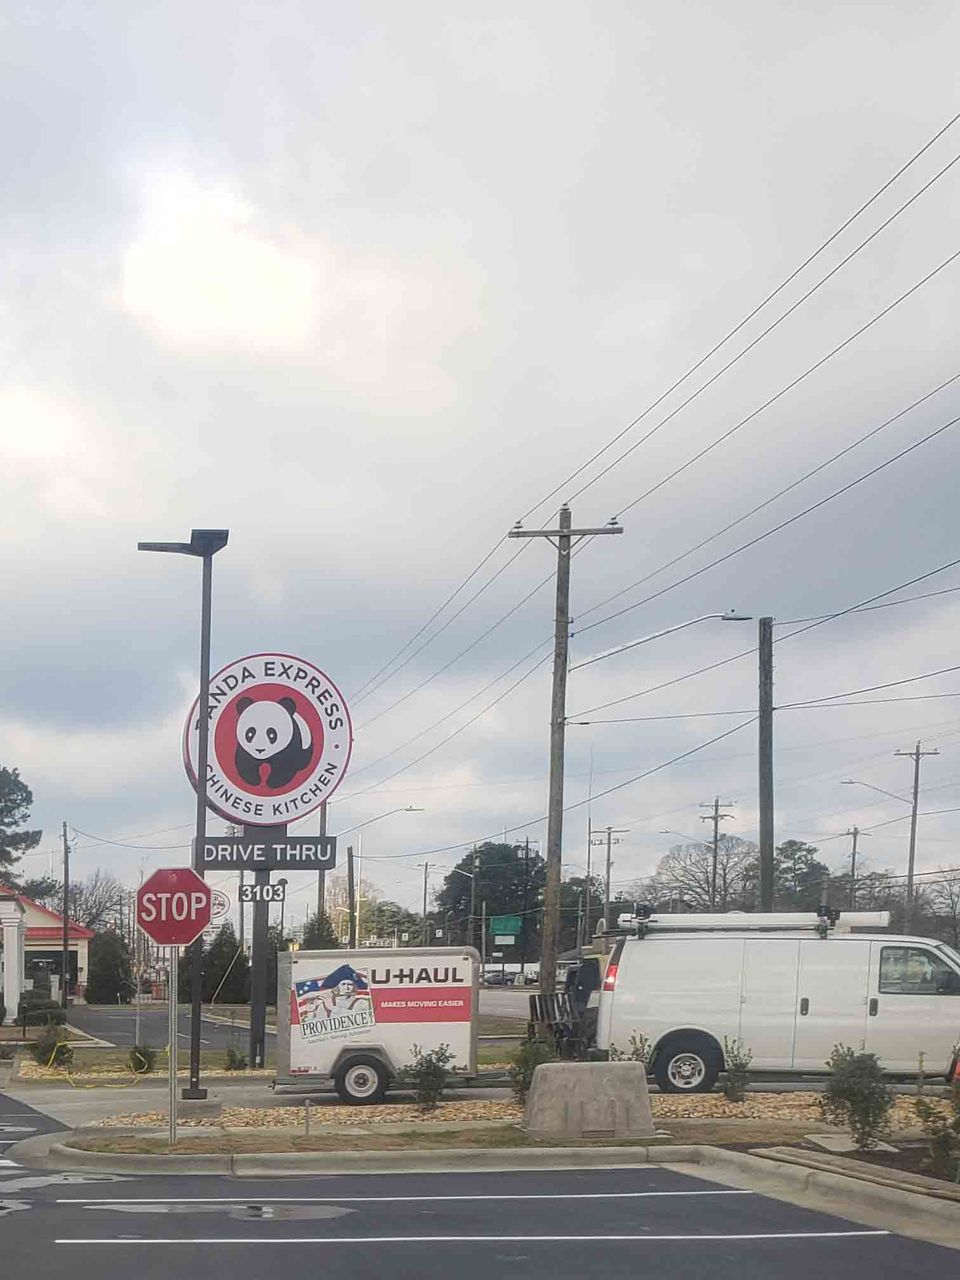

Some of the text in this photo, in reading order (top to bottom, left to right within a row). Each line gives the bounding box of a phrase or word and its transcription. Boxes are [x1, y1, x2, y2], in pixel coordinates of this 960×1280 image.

[264, 661, 343, 730] EXPRESS
[272, 762, 338, 816] KITCHEN
[204, 844, 331, 861] DRIVE THRU
[242, 885, 284, 901] 3103
[141, 892, 207, 922] STOP
[371, 967, 464, 984] U-HAUL
[381, 1000, 406, 1008] MAKES
[407, 1000, 437, 1008] MOVING
[302, 1011, 369, 1036] PROVIDENCE
